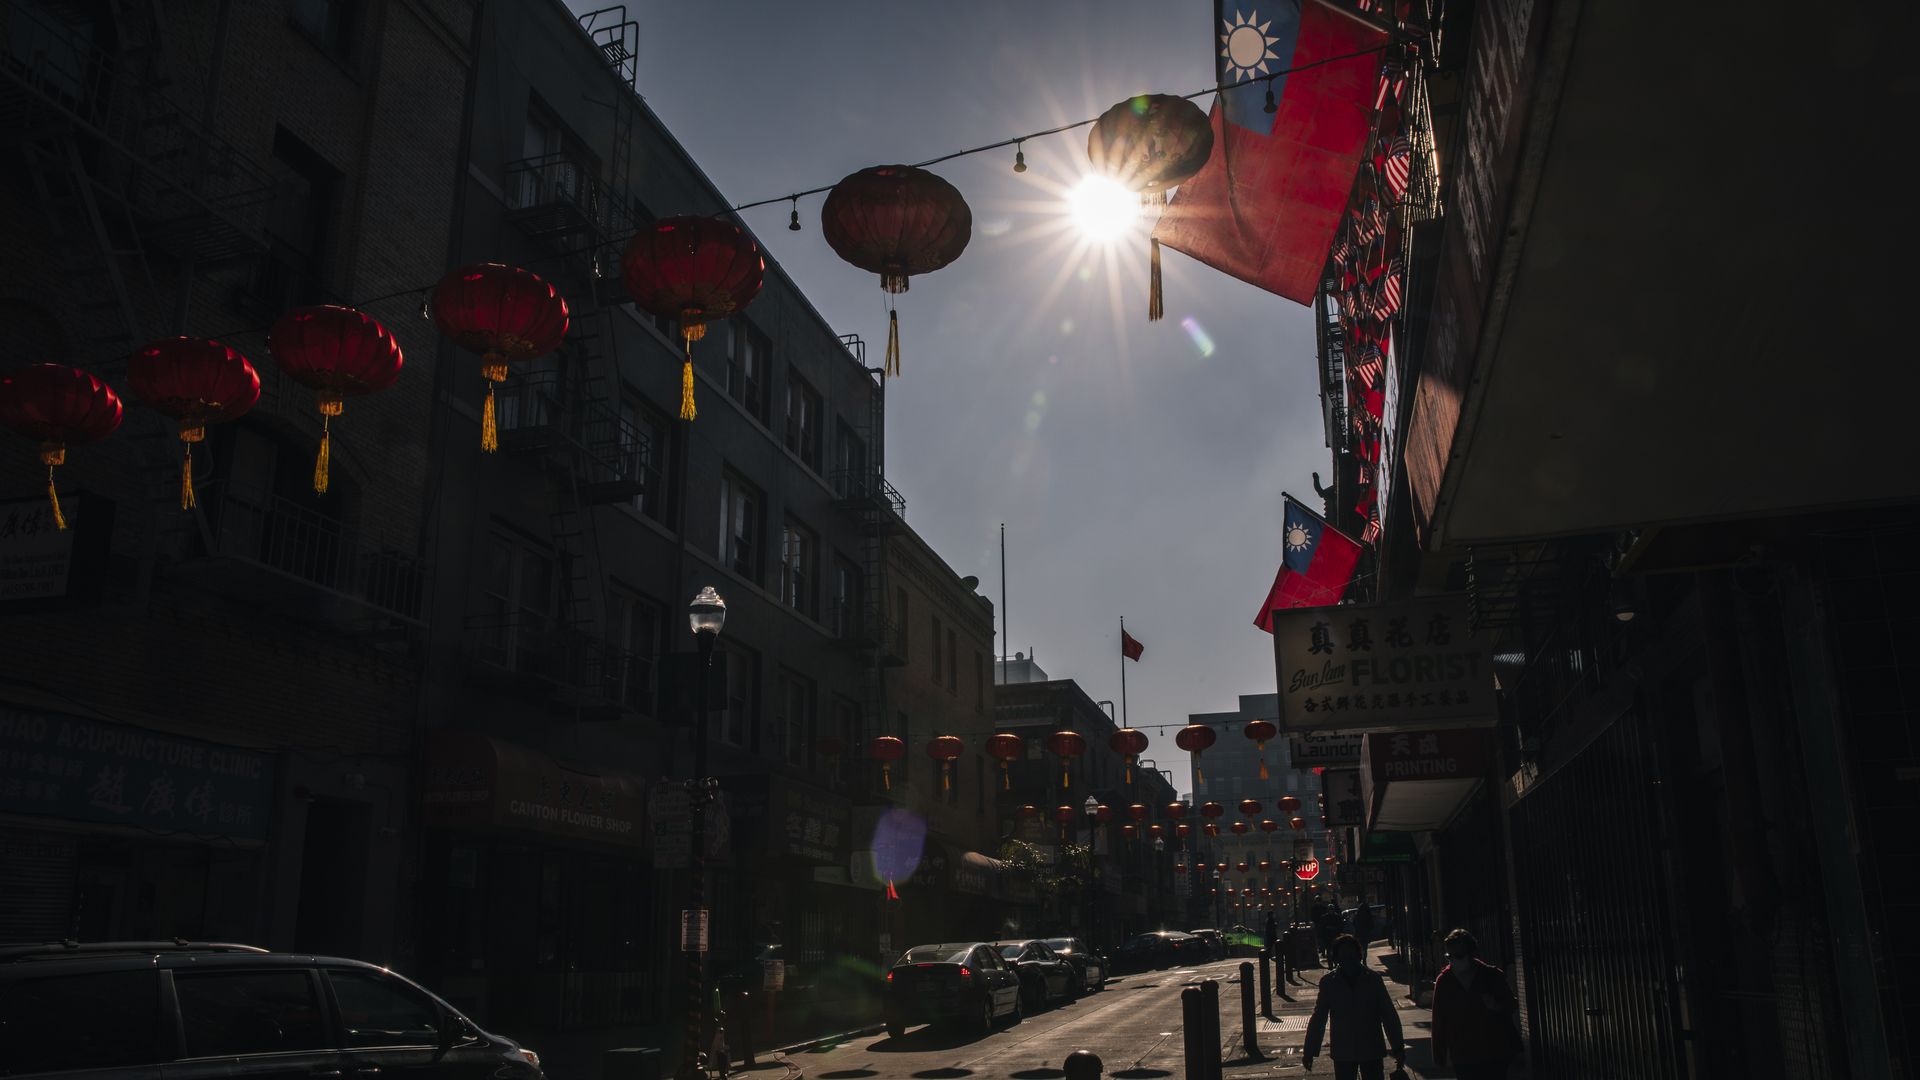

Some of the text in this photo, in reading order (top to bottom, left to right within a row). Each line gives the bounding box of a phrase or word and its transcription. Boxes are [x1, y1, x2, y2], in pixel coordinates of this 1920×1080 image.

[1307, 612, 1452, 655] 真真花店
[1288, 651, 1481, 693] Sun Lam FLORIST
[56, 721, 205, 769] ACUPUNCTURE
[209, 751, 262, 779] CLINIC
[1384, 758, 1457, 776] PRINTING
[510, 800, 632, 833] CANTON FLOWER SHOP
